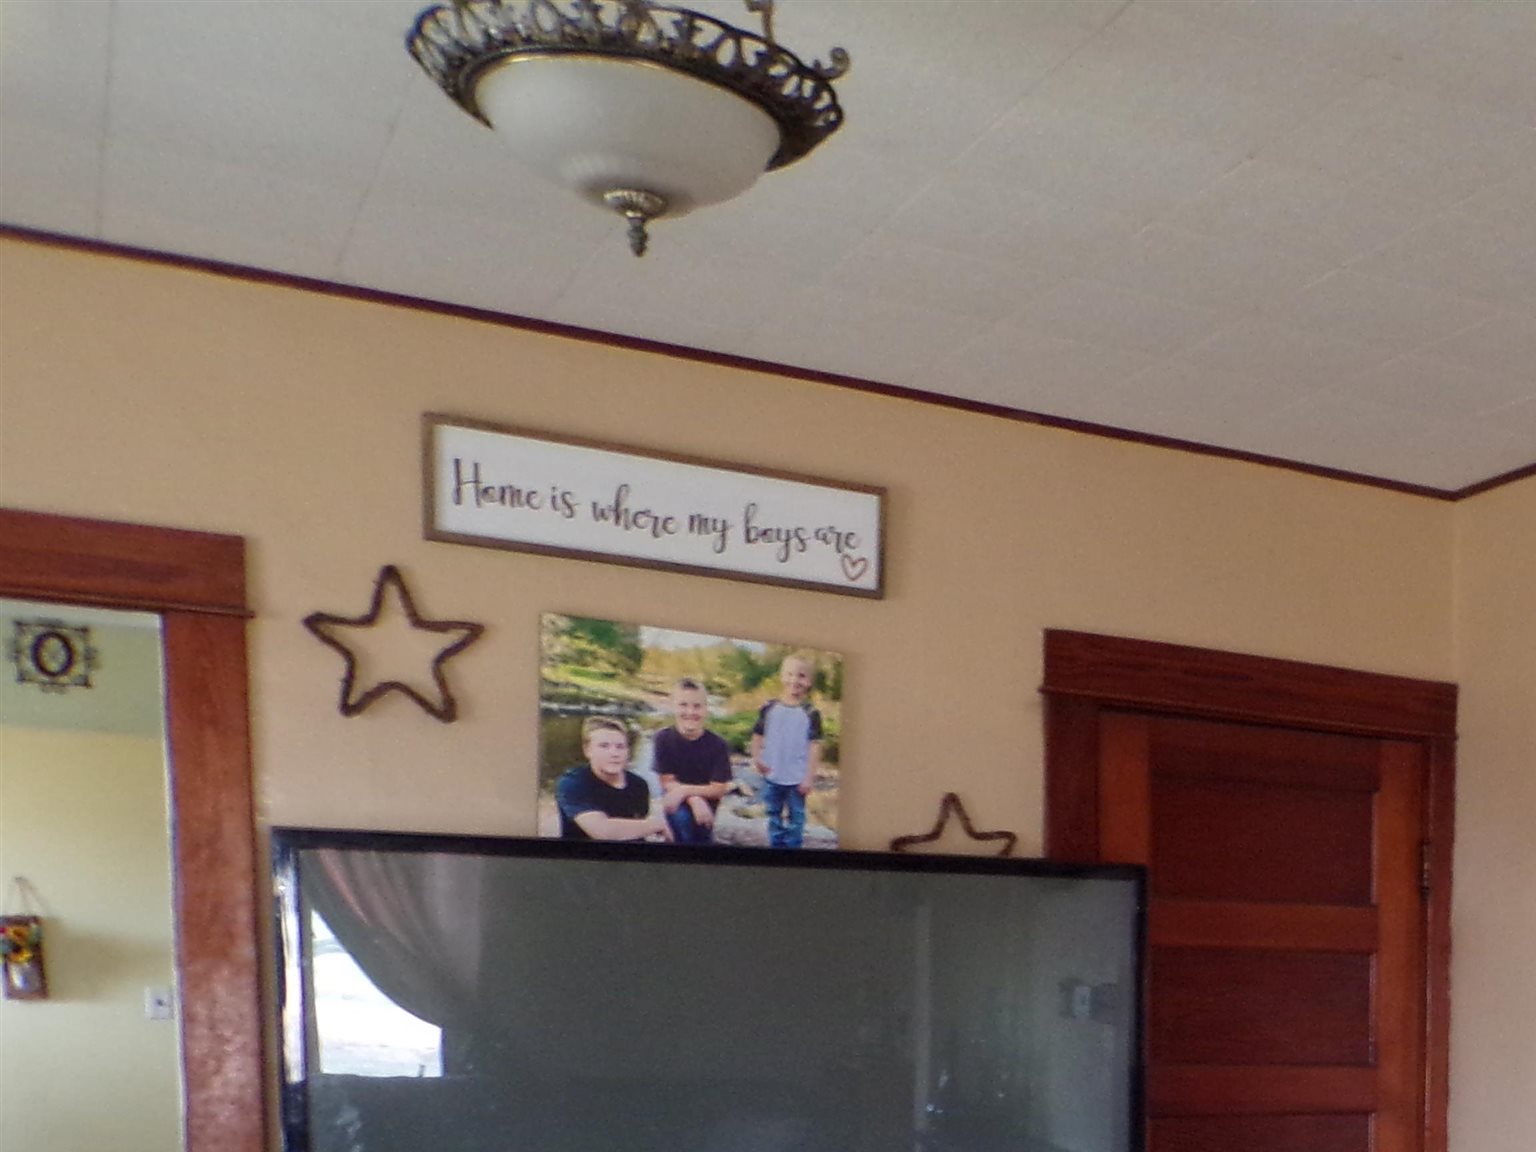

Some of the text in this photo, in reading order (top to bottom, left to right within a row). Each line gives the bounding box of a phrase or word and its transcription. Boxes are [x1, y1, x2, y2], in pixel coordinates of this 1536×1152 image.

[453, 457, 860, 564] Home is where my boys are
